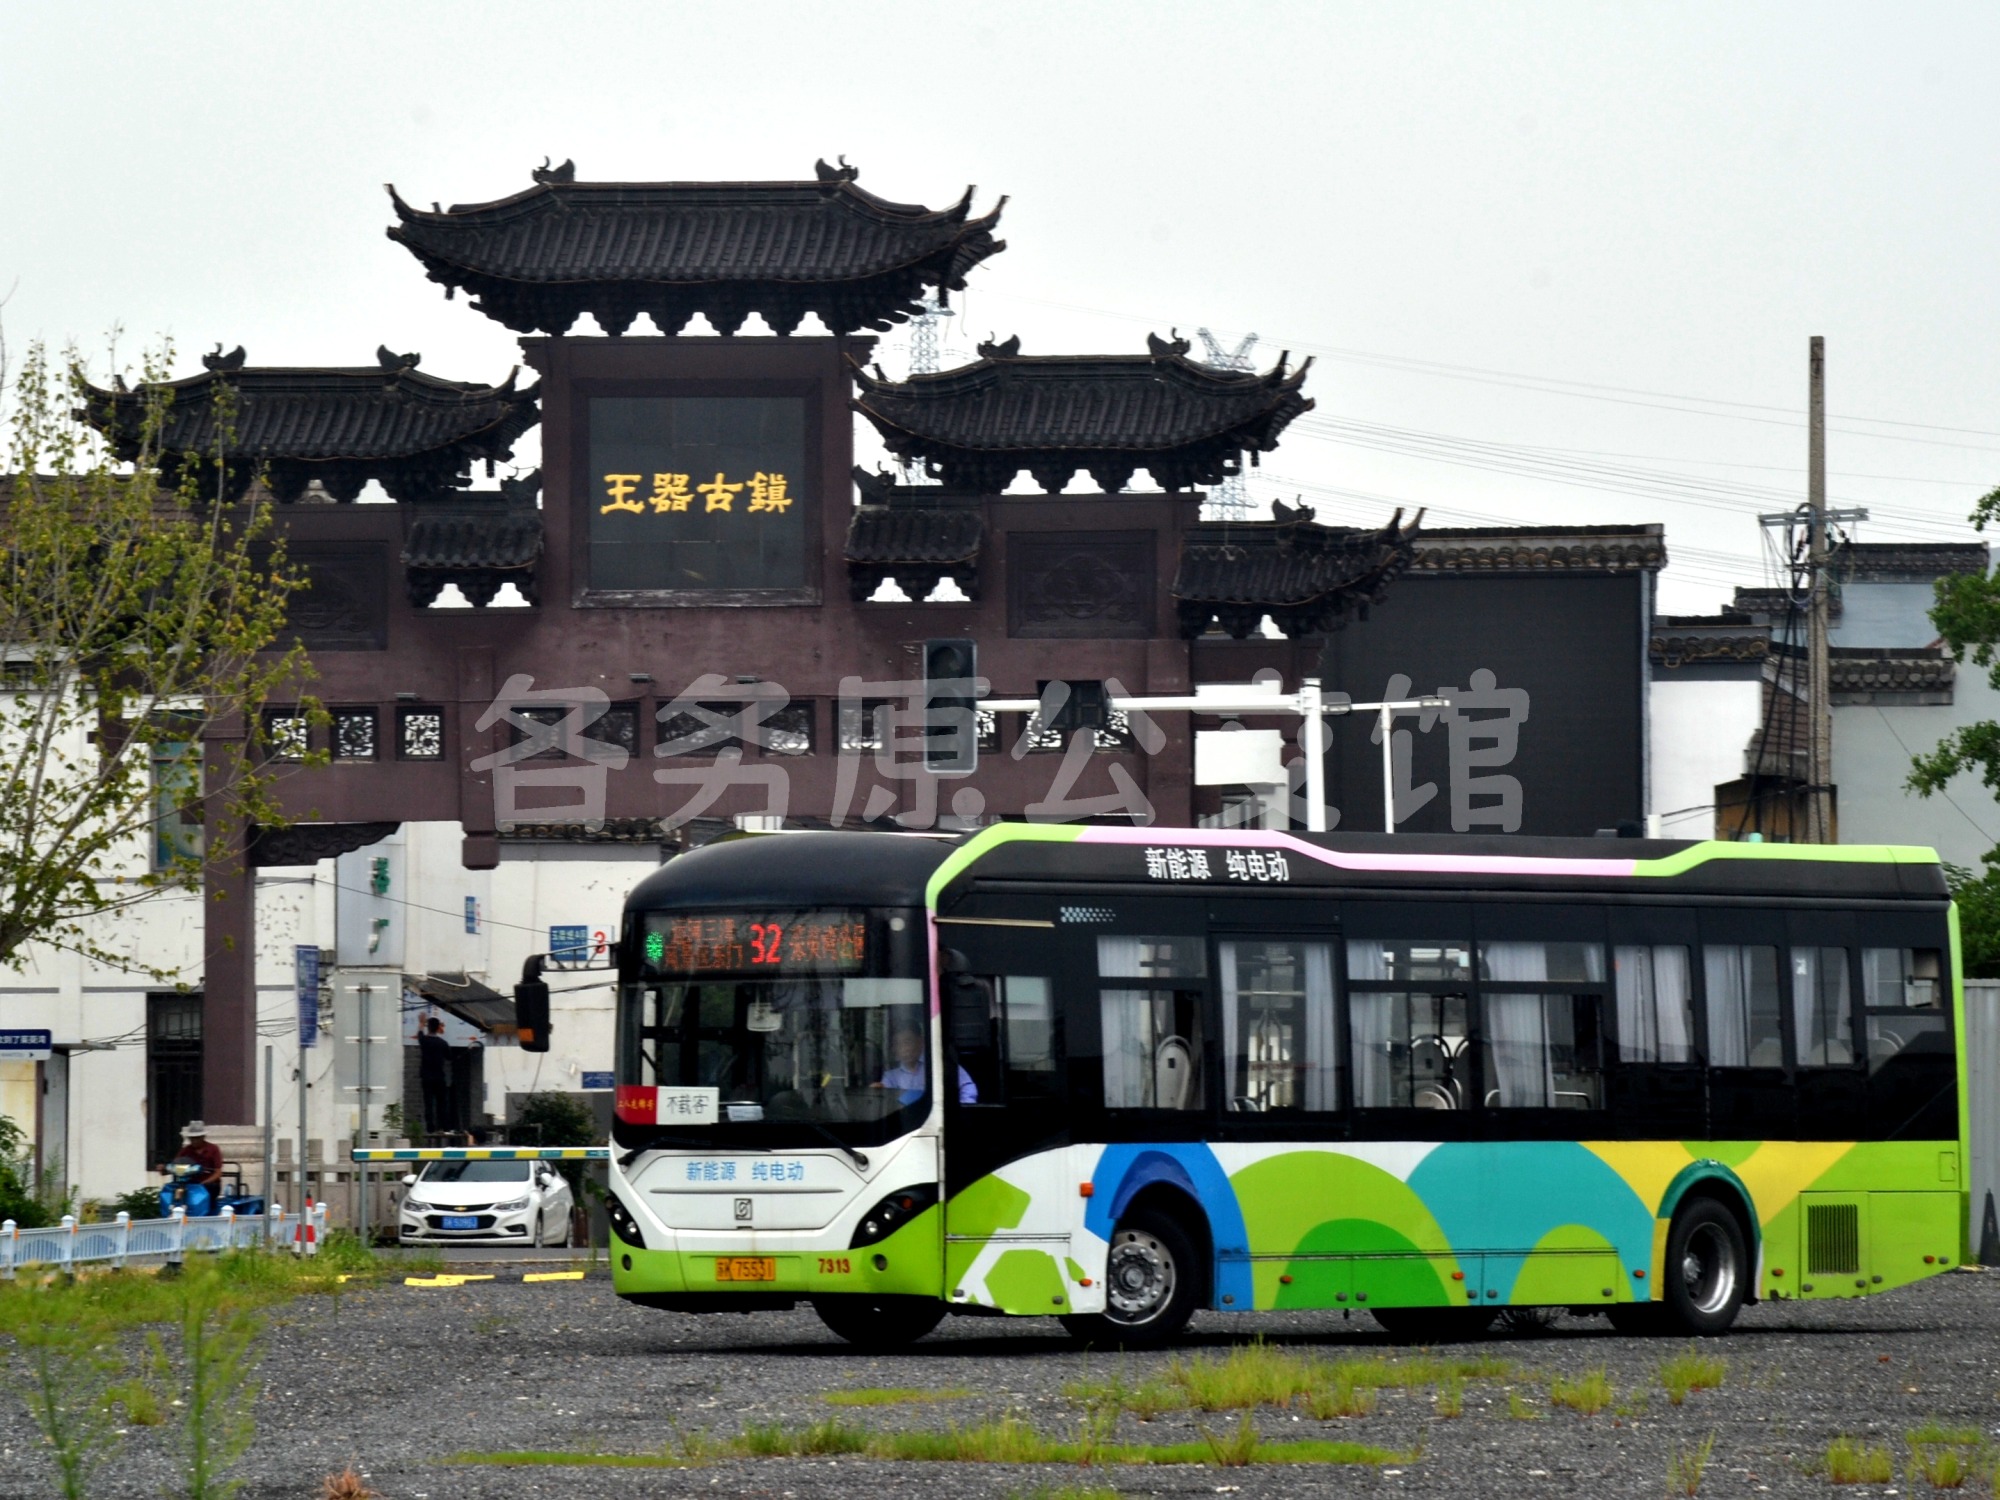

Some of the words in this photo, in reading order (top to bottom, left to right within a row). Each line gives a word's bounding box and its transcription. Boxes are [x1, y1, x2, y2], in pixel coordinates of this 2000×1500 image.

[1144, 847, 1211, 880] 新能源
[1225, 849, 1290, 882] 纯电动
[594, 930, 607, 954] 3
[750, 923, 783, 964] 32
[666, 1093, 710, 1115] 不载客
[686, 1160, 737, 1181] 新能源
[752, 1161, 805, 1181] 纯电动
[818, 1258, 851, 1273] 7313
